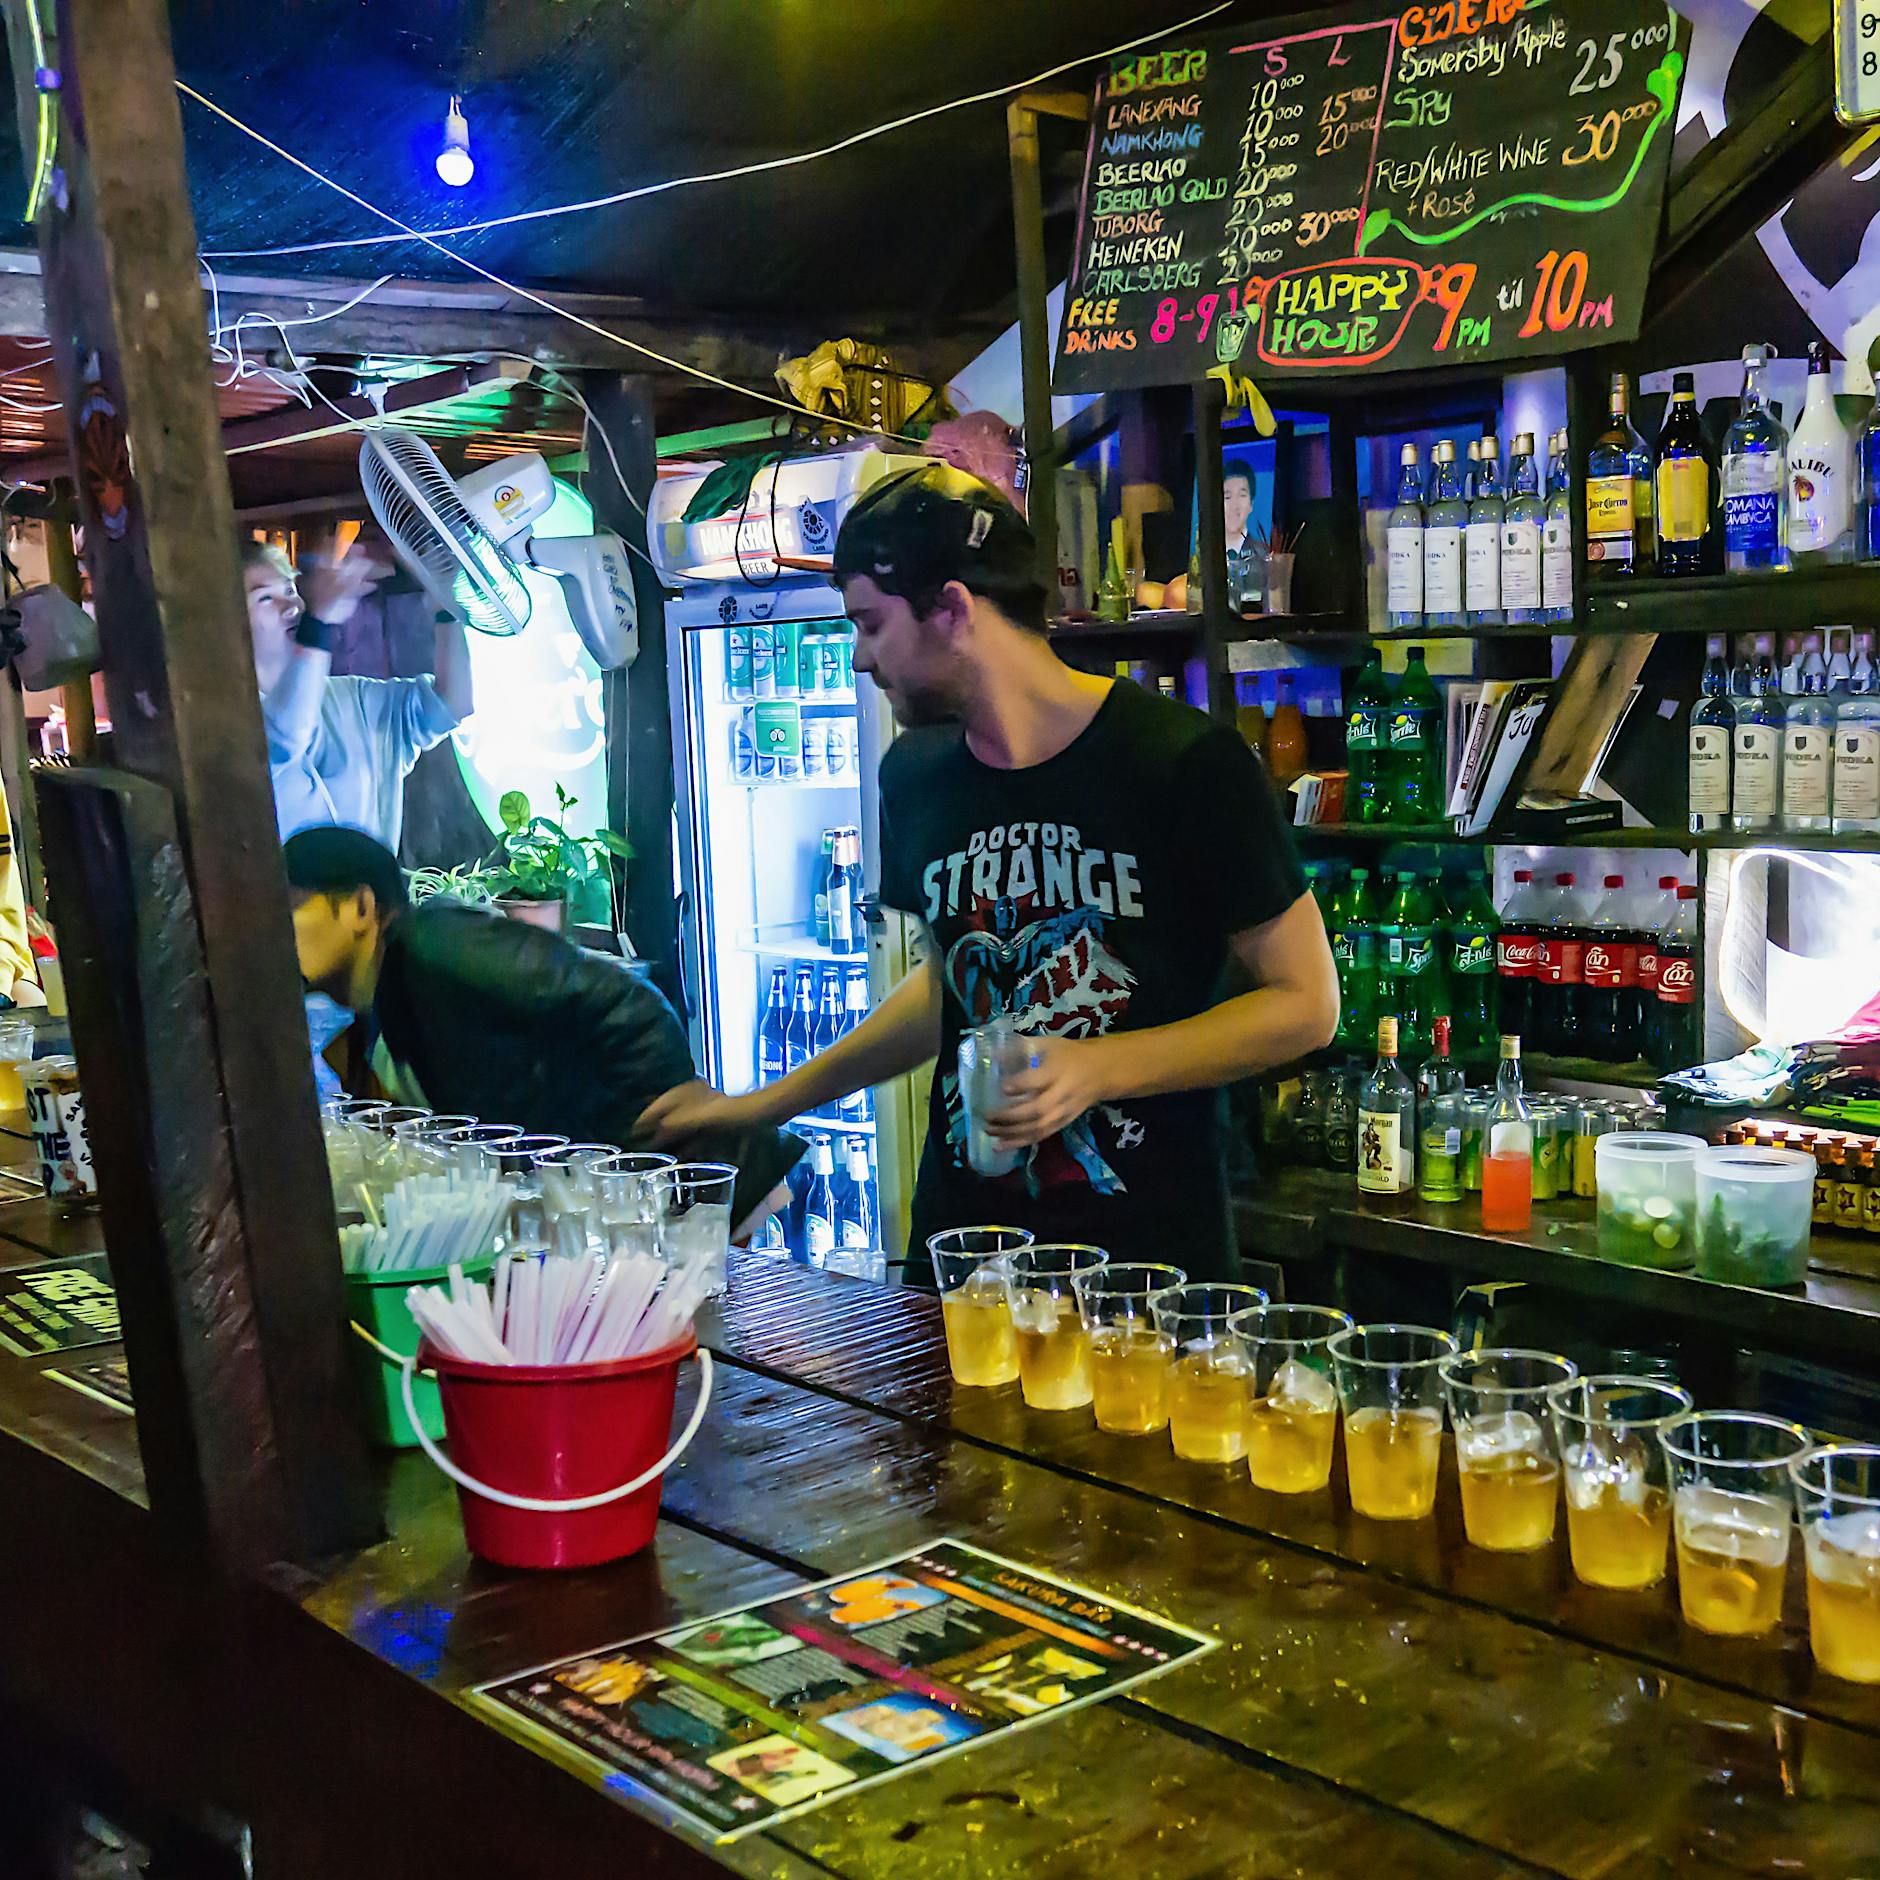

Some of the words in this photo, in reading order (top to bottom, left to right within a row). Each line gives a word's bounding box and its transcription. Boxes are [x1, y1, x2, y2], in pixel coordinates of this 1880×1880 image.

[1264, 46, 1288, 77] S
[1327, 35, 1352, 67] L
[1513, 20, 1567, 67] Apple
[1106, 49, 1208, 98] BEER
[1862, 51, 1878, 77] 8
[1180, 177, 1229, 204] GOLD
[1092, 209, 1166, 239] TUBORG
[1088, 230, 1184, 268] HEINEKEN
[1274, 269, 1409, 316] HAPPY
[1517, 250, 1589, 338] 10
[1067, 298, 1120, 329] FREE
[1270, 315, 1379, 355] HOUR
[1789, 458, 1836, 478] ALIBU
[1725, 497, 1776, 513] OMANA
[742, 561, 769, 575] BEER
[966, 822, 1082, 858] DOCTOR
[922, 843, 1144, 924] STRANGE
